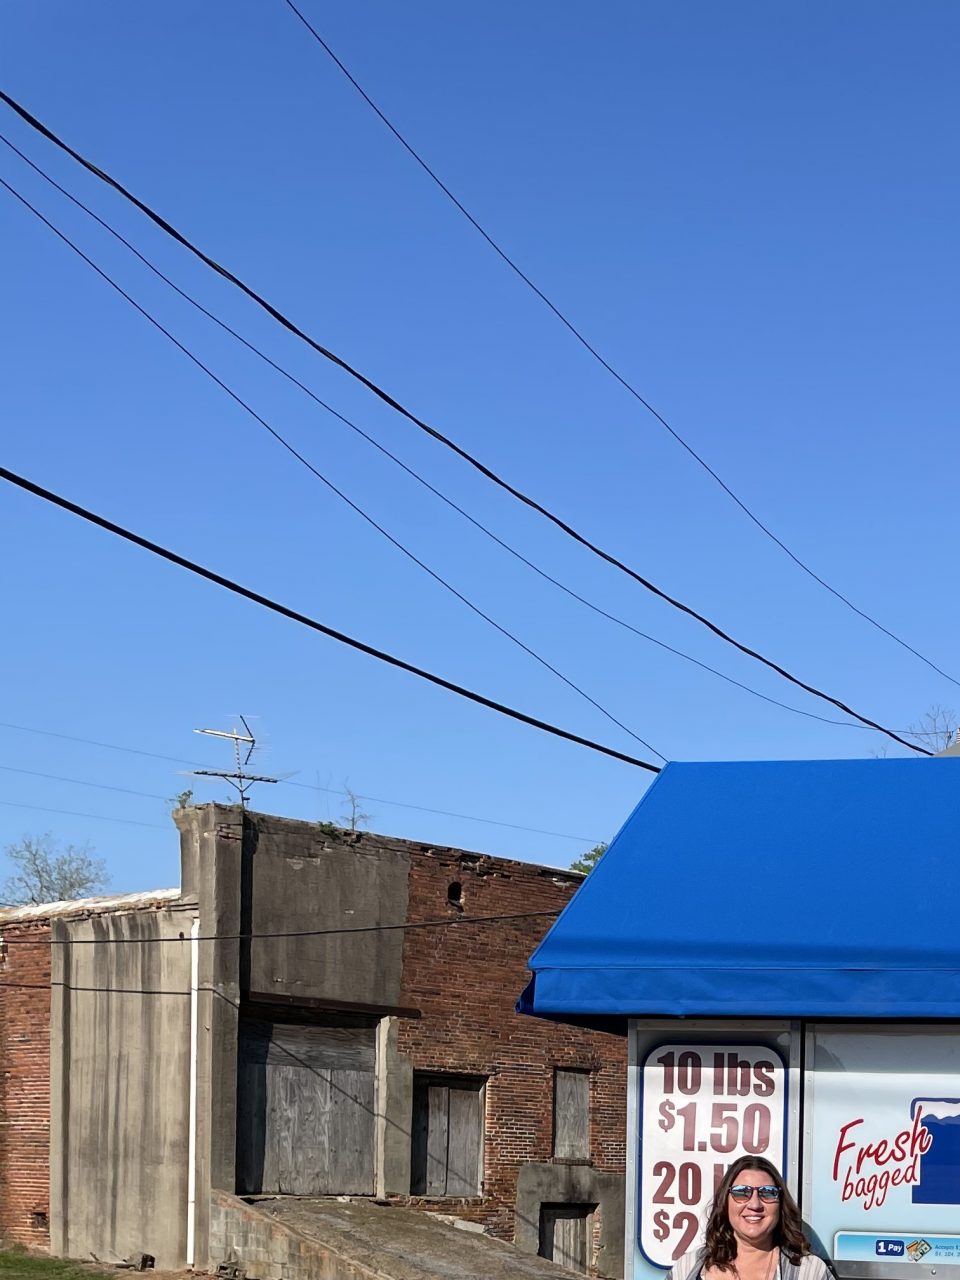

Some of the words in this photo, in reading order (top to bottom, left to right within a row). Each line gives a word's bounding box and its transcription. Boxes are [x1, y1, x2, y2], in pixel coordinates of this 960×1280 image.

[657, 1051, 702, 1095] 10
[713, 1052, 775, 1097] lbs
[658, 1098, 771, 1154] $1.50
[832, 1105, 932, 1180] Fresh
[652, 1161, 702, 1205] 20
[842, 1154, 918, 1211] bagged
[877, 1241, 887, 1253] 1
[888, 1243, 902, 1253] Pay
